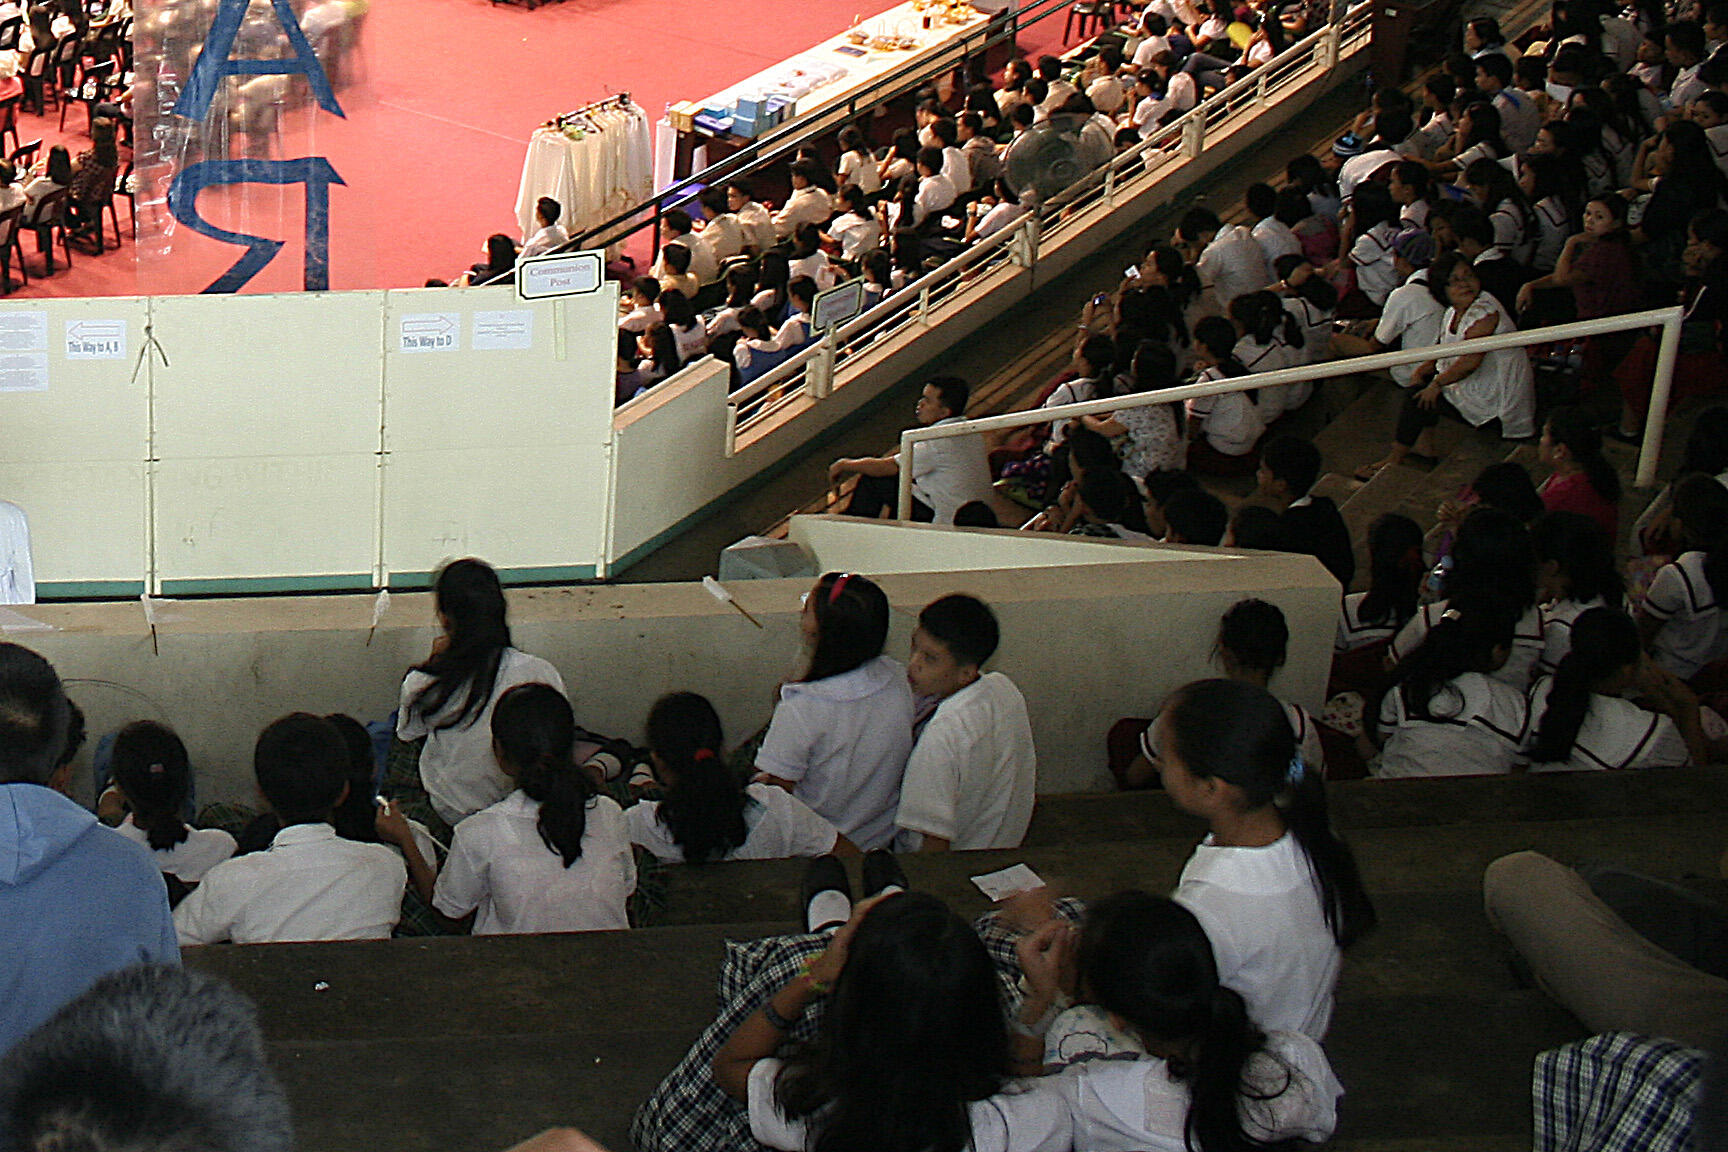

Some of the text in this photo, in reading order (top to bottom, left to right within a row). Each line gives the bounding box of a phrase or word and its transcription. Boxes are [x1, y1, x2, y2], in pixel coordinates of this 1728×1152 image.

[530, 263, 591, 277] Communion
[550, 277, 570, 287] Post
[68, 341, 81, 353] This
[83, 341, 96, 355] Way
[98, 341, 104, 352] to
[403, 336, 418, 347] This
[420, 336, 434, 349] Way
[437, 336, 445, 346] to
